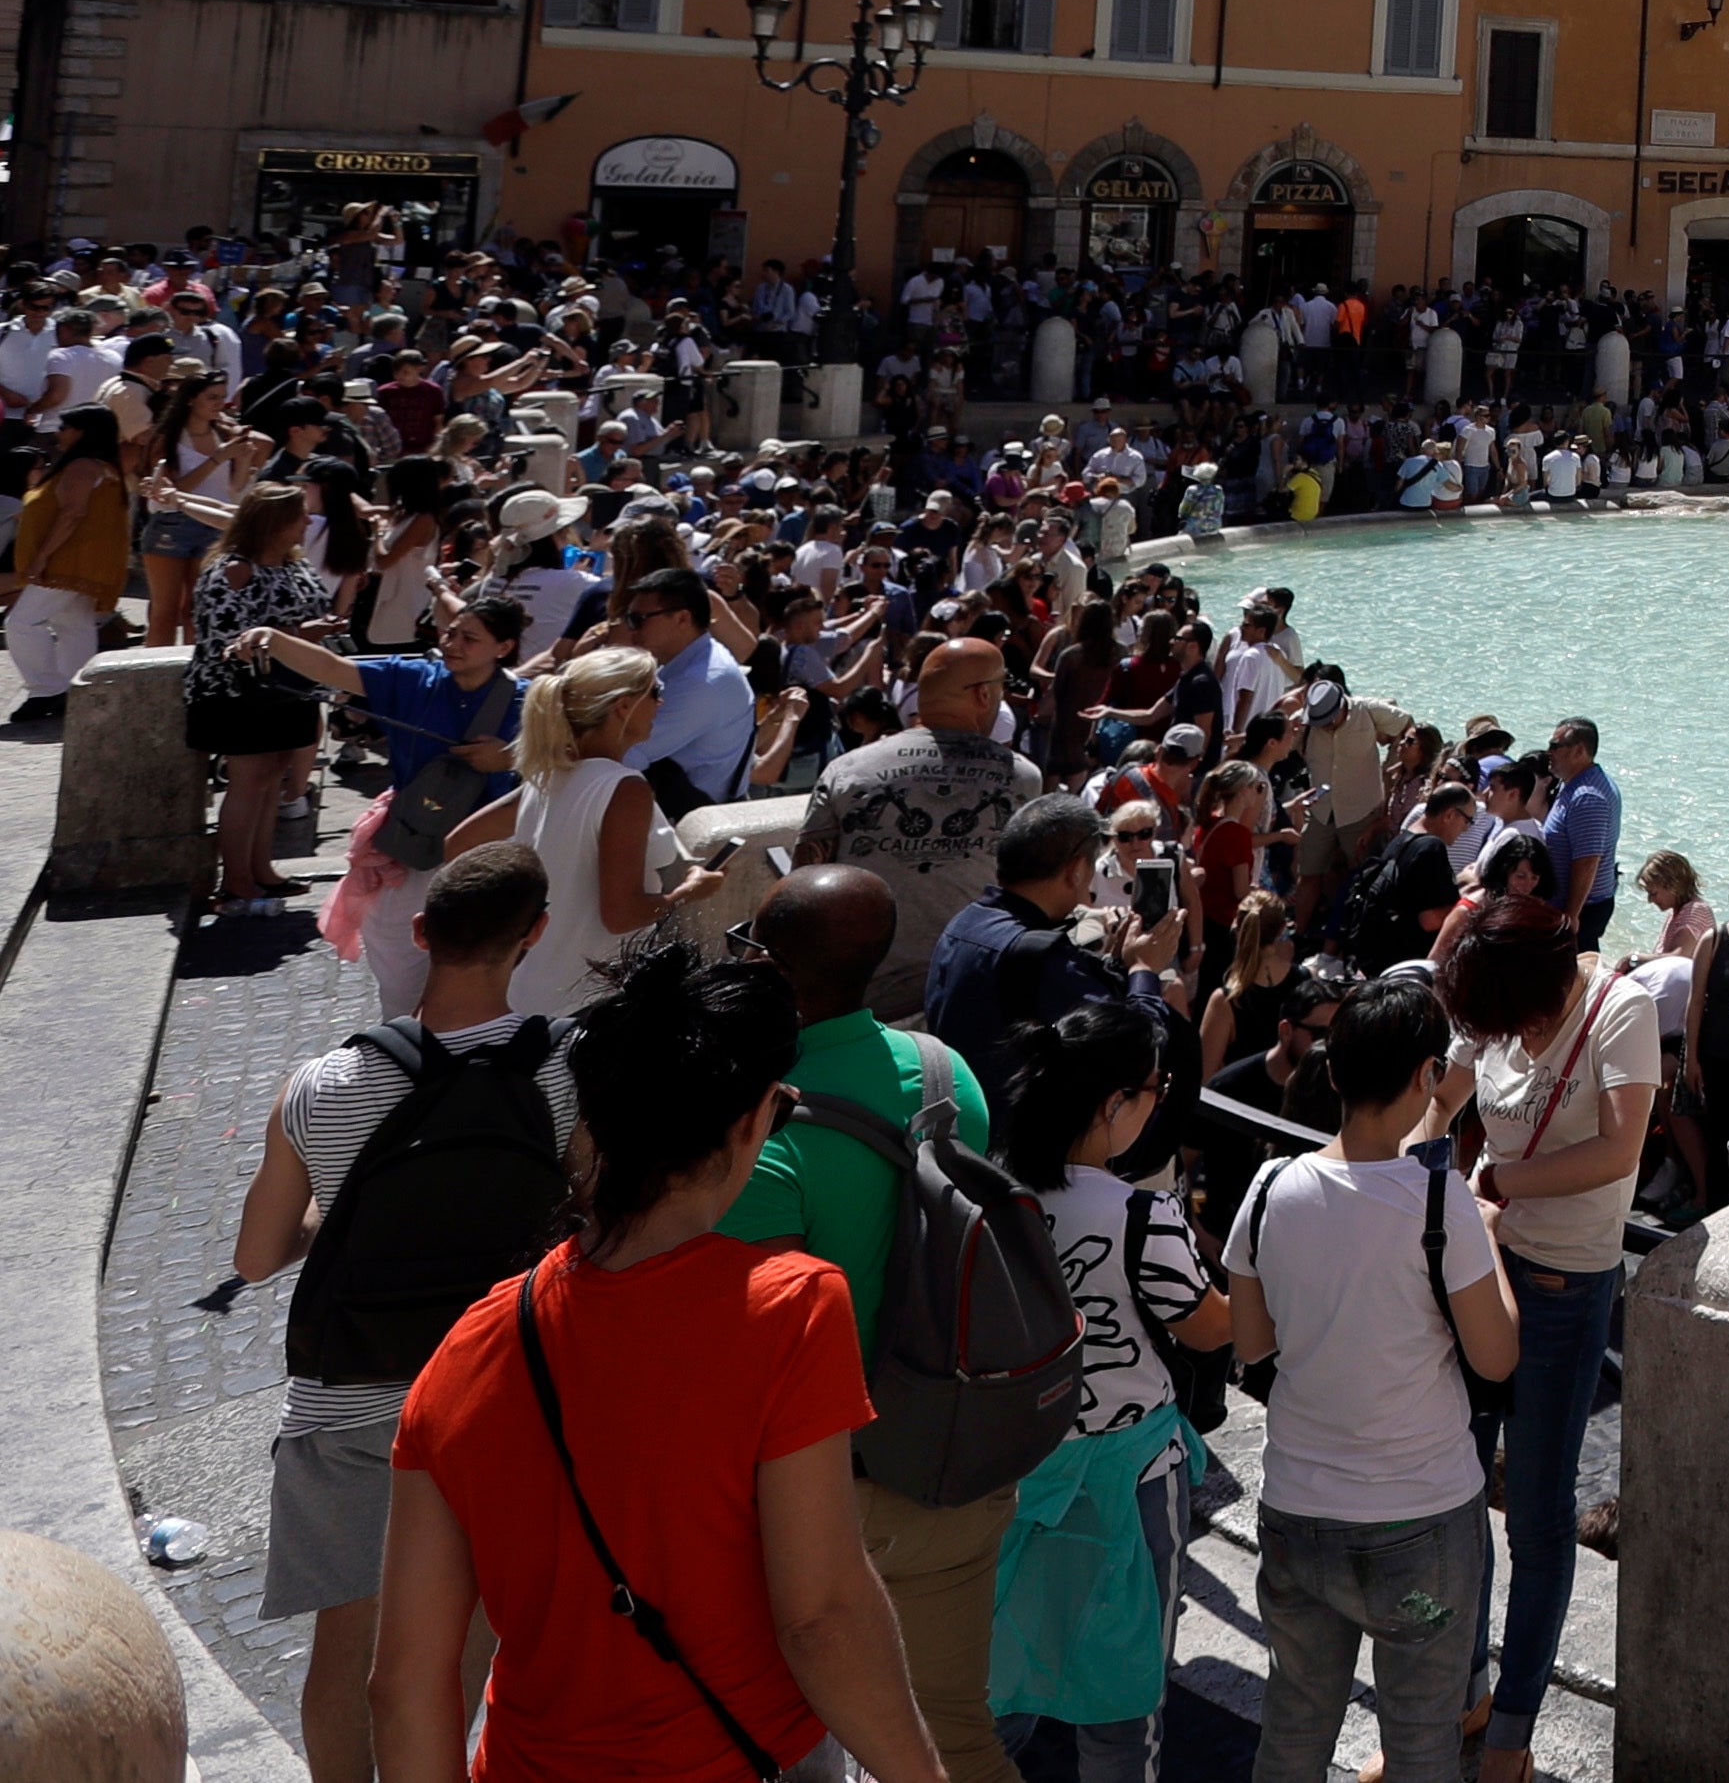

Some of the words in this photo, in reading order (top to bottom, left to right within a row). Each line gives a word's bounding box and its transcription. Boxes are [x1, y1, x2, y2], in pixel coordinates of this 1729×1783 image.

[314, 153, 431, 172] GIORGIO
[602, 163, 717, 185] Gelateria
[1092, 179, 1170, 198] GELATI
[1271, 184, 1335, 201] PIZZA
[876, 765, 949, 782] VINTAGE
[956, 767, 1013, 787] MOTORS
[879, 837, 984, 853] CALIFORNIA
[1529, 1065, 1581, 1109] Dep
